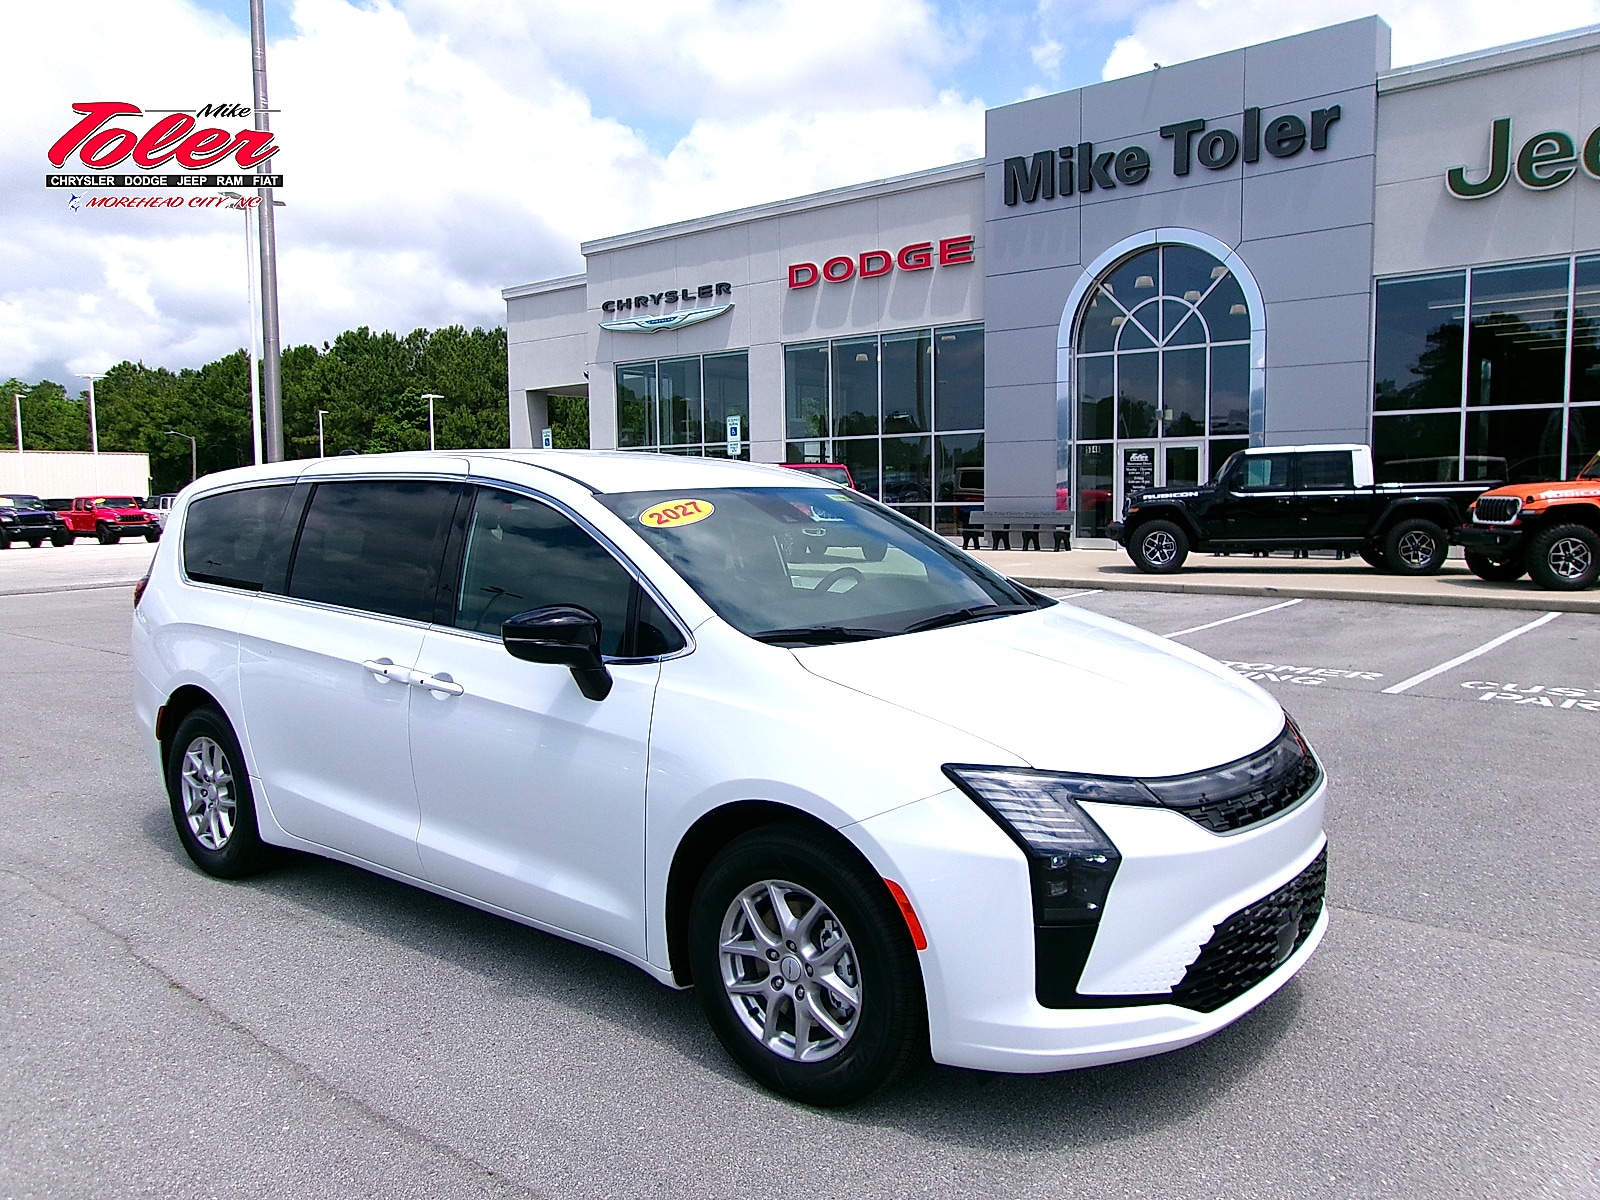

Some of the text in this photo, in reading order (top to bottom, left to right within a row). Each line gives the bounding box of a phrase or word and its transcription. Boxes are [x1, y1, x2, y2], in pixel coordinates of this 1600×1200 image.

[1003, 105, 1341, 206] Mike Toler
[788, 235, 975, 290] DODGE
[601, 282, 732, 312] CHRYSLER
[1143, 491, 1198, 500] RUBICON
[648, 501, 704, 525] 2027
[1460, 680, 1600, 697] CUS
